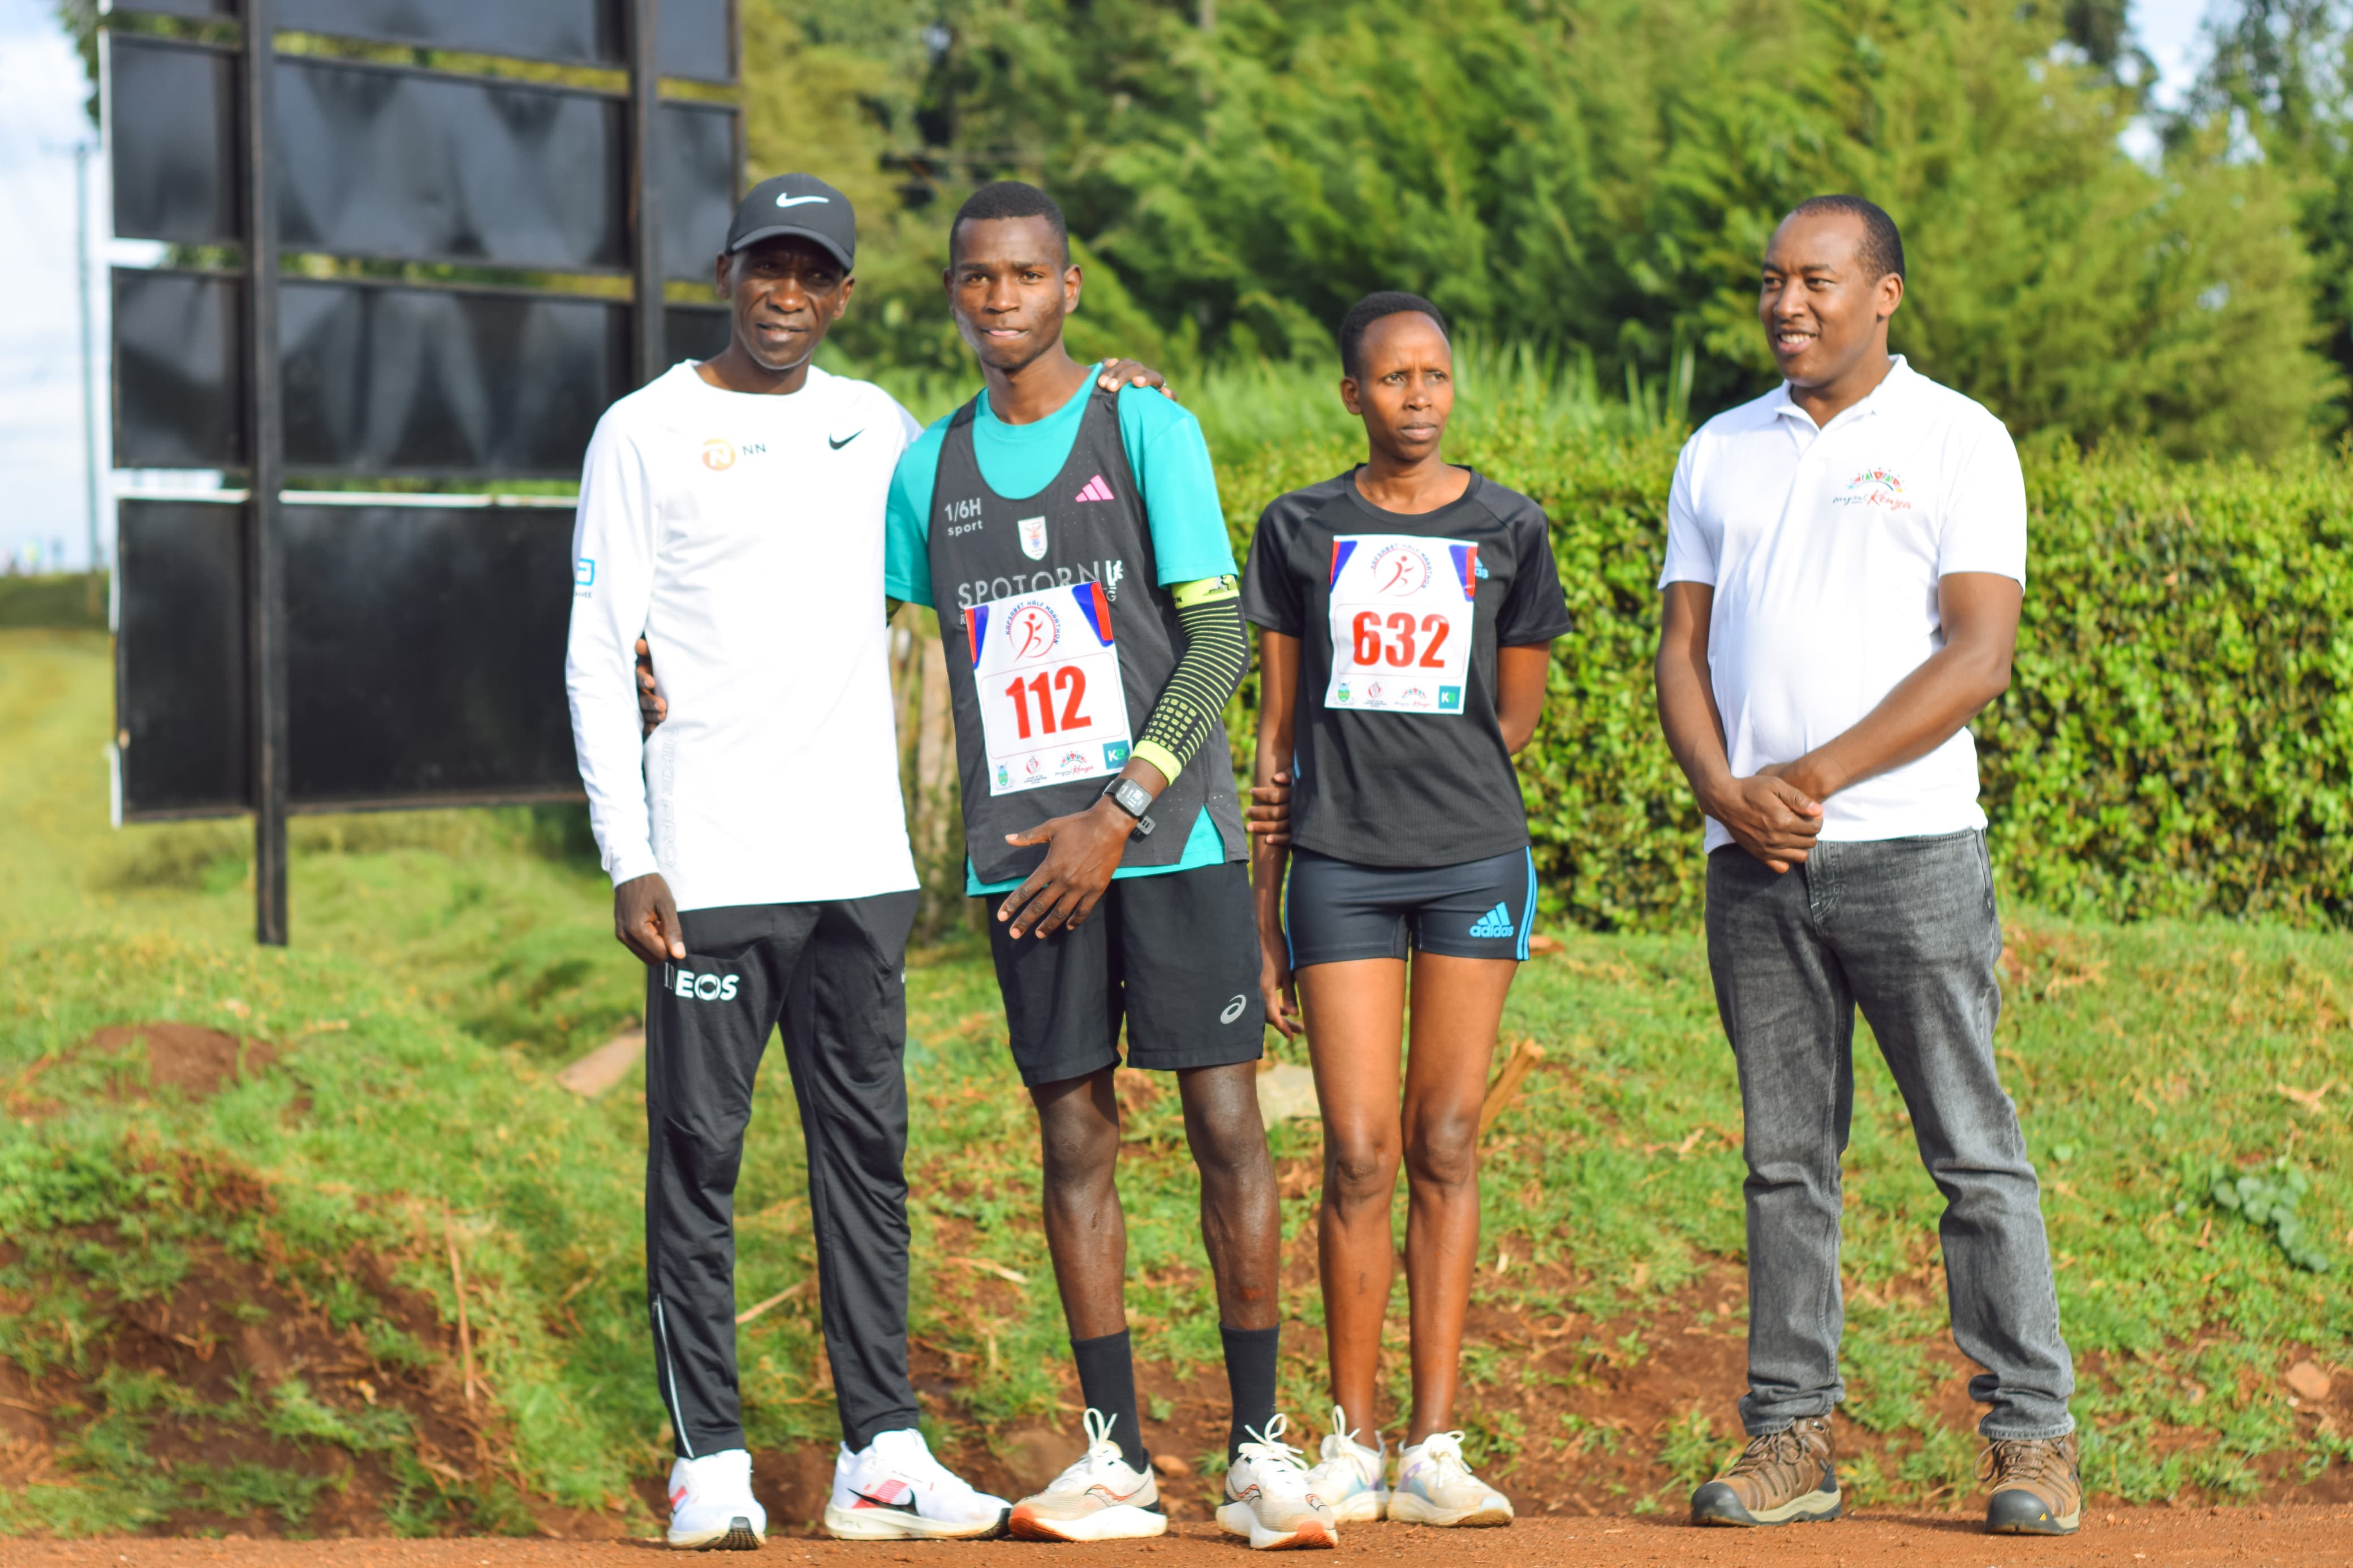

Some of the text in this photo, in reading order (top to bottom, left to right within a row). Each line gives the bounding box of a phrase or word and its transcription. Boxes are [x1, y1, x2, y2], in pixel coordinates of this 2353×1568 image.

[742, 443, 766, 455] NN
[945, 498, 981, 522] 1/6H
[947, 520, 983, 537] sport
[1371, 542, 1399, 569] KAPSABET
[1420, 552, 1433, 589] MARATHON
[1006, 602, 1024, 635] KAPSABET
[1045, 605, 1061, 645] MARATHON
[1352, 611, 1450, 668] 632
[1005, 665, 1092, 740] 112
[660, 726, 679, 867] NIKE PRO
[1469, 923, 1514, 938] adidas
